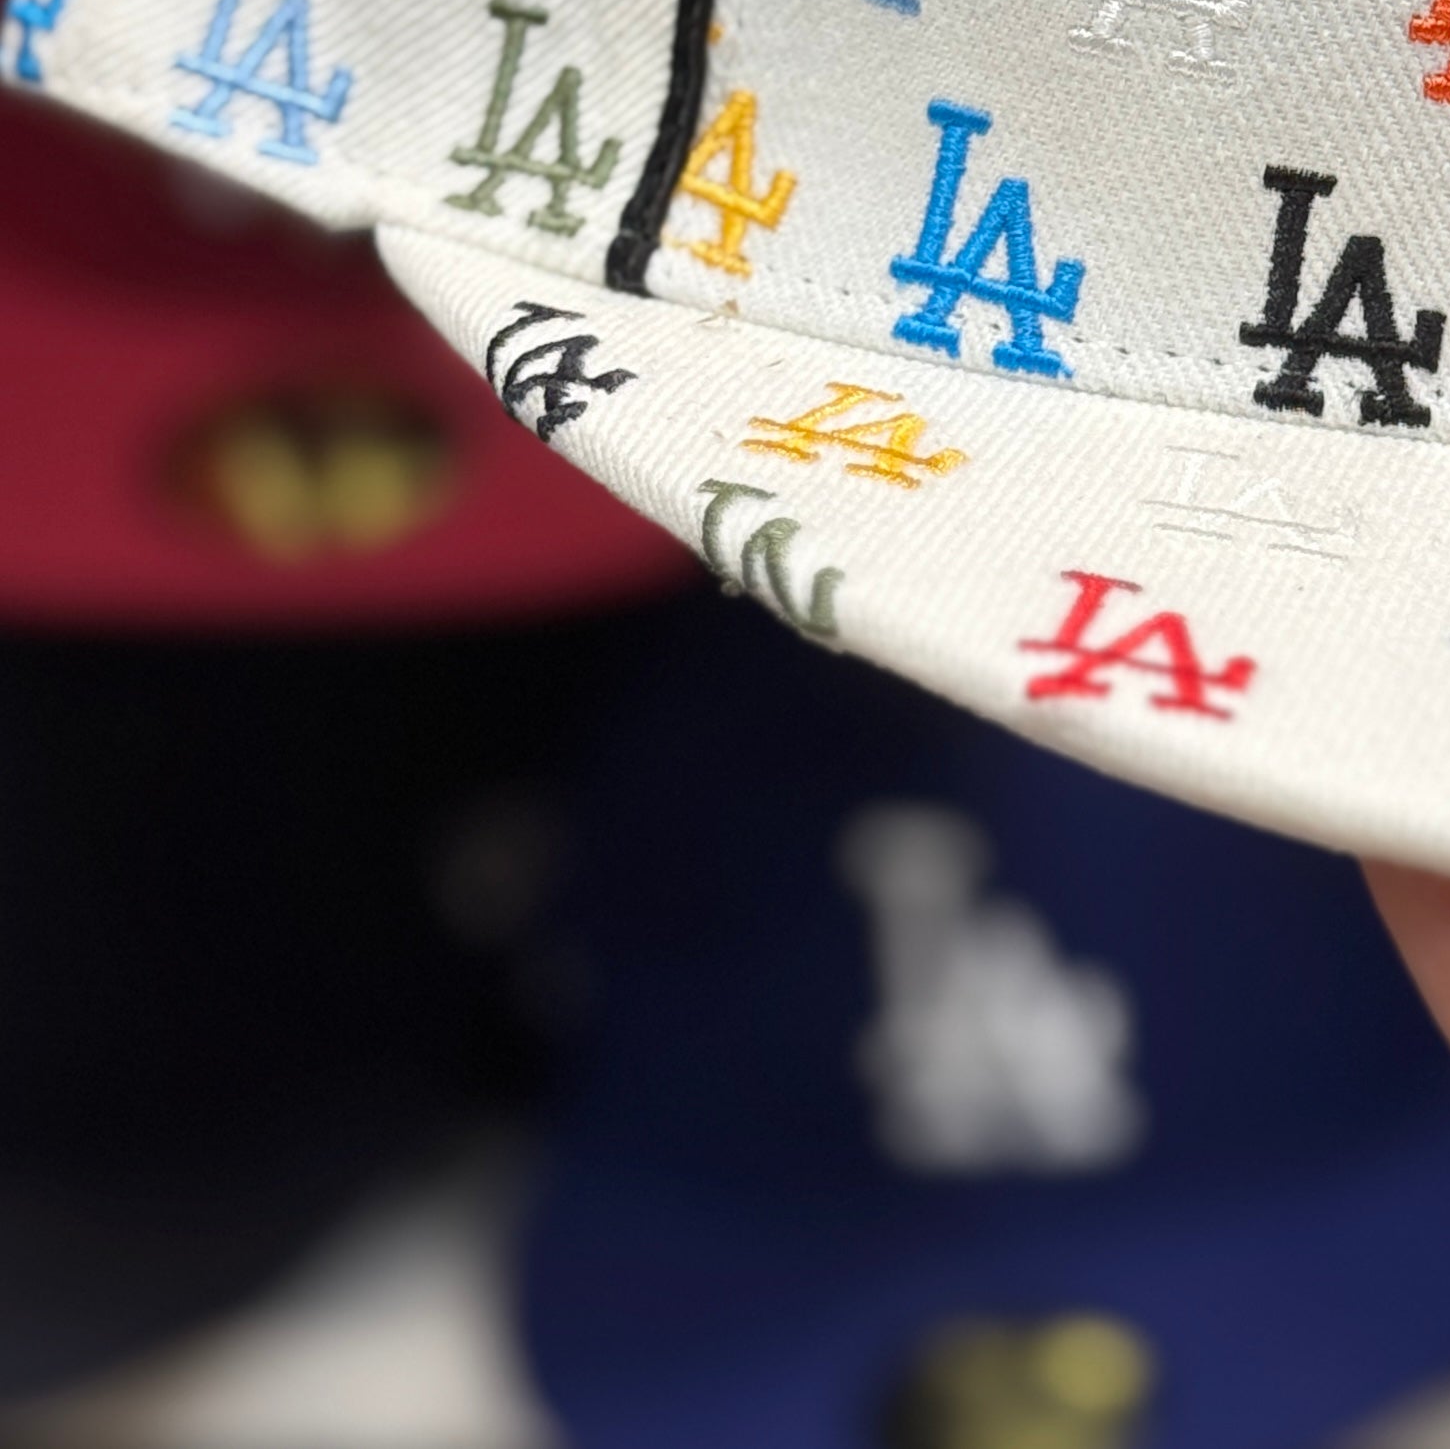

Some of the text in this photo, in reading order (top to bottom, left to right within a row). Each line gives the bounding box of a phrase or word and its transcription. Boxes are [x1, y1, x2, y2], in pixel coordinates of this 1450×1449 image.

[665, 88, 800, 280] A
[889, 100, 1085, 378] LA
[486, 300, 638, 442] LA
[1240, 166, 1446, 427] LA
[741, 381, 970, 490] LA
[1143, 443, 1359, 557] LA
[1021, 570, 1257, 720] LA
